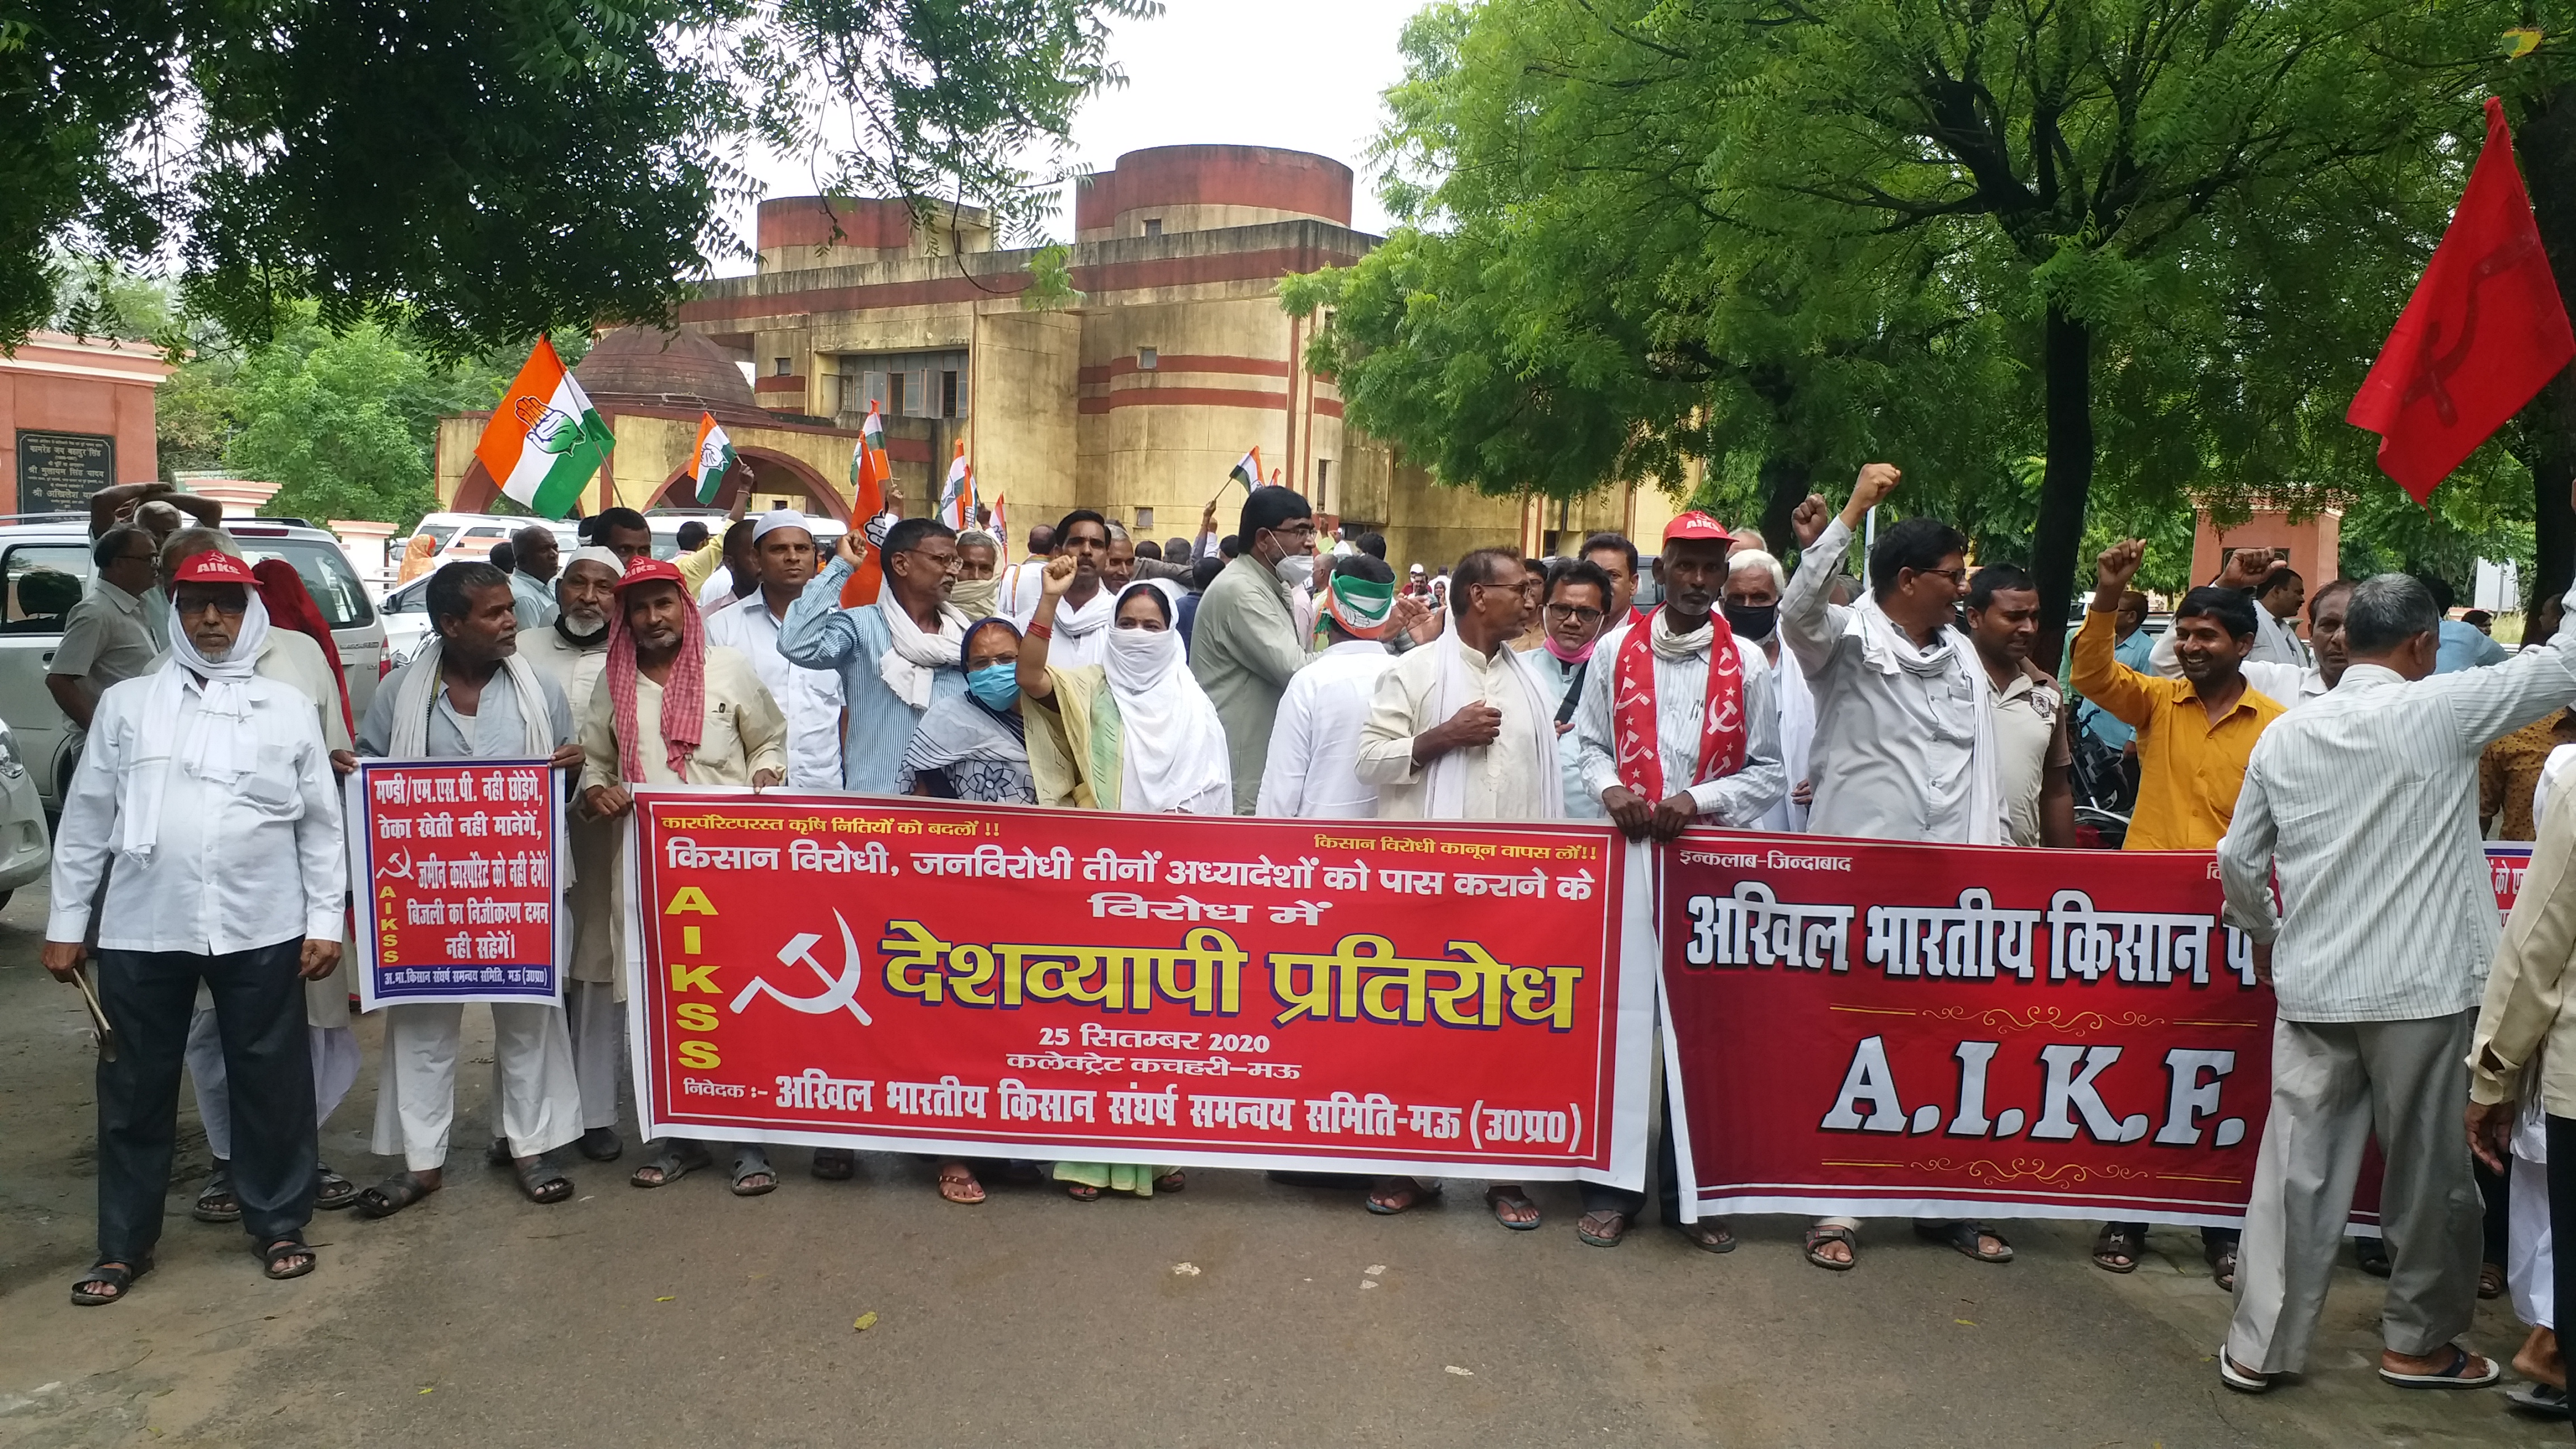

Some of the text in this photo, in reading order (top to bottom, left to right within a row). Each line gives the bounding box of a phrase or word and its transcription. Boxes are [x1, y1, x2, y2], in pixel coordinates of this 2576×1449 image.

[197, 562, 241, 574] AIKS
[482, 770, 504, 801] नही
[377, 814, 412, 839] ठेका
[416, 812, 454, 837] खेती
[458, 811, 489, 836] नही
[789, 816, 827, 835] कृषि
[831, 817, 896, 835] नितियों
[897, 819, 924, 835] को
[928, 820, 979, 836] बदलों
[1314, 834, 1376, 851] किसान
[1381, 837, 1436, 853] विरोधी
[1441, 842, 1497, 861] कानून
[1500, 845, 1552, 859] वापस
[416, 853, 446, 889] जमीन
[491, 851, 506, 887] को
[509, 851, 527, 887] नही
[666, 837, 1595, 901] किसान विरोधी, जनविरोधी तीनों अध्यादेशों को पास कराने के
[406, 897, 549, 925] बिजली का निजीकरण दमन
[1087, 892, 1333, 926] विरोध में
[444, 931, 472, 959] नही
[1687, 880, 1855, 971] अखिल
[1865, 887, 2041, 978] भारतीय
[2047, 889, 2215, 984] किसान
[433, 967, 451, 983] संघर्ष
[452, 970, 479, 983] समन्वय
[879, 920, 1584, 1030] देशव्यापी प्रतिरोध
[1039, 1023, 1270, 1053] 25 सितम्बर 2020
[1006, 1050, 1303, 1079] कलेक्ट्रेट कचहरी-मऊ
[683, 1077, 746, 1098] निवेदक
[775, 1068, 875, 1112] अखिल
[886, 1075, 989, 1119] भारतीय
[998, 1078, 1097, 1123] किसान
[1107, 1082, 1178, 1126] संघर्ष
[1188, 1093, 1296, 1131] समन्वय
[1304, 1091, 1462, 1139] समिति-मऊ
[1820, 1034, 2246, 1147] A.I.K.F.
